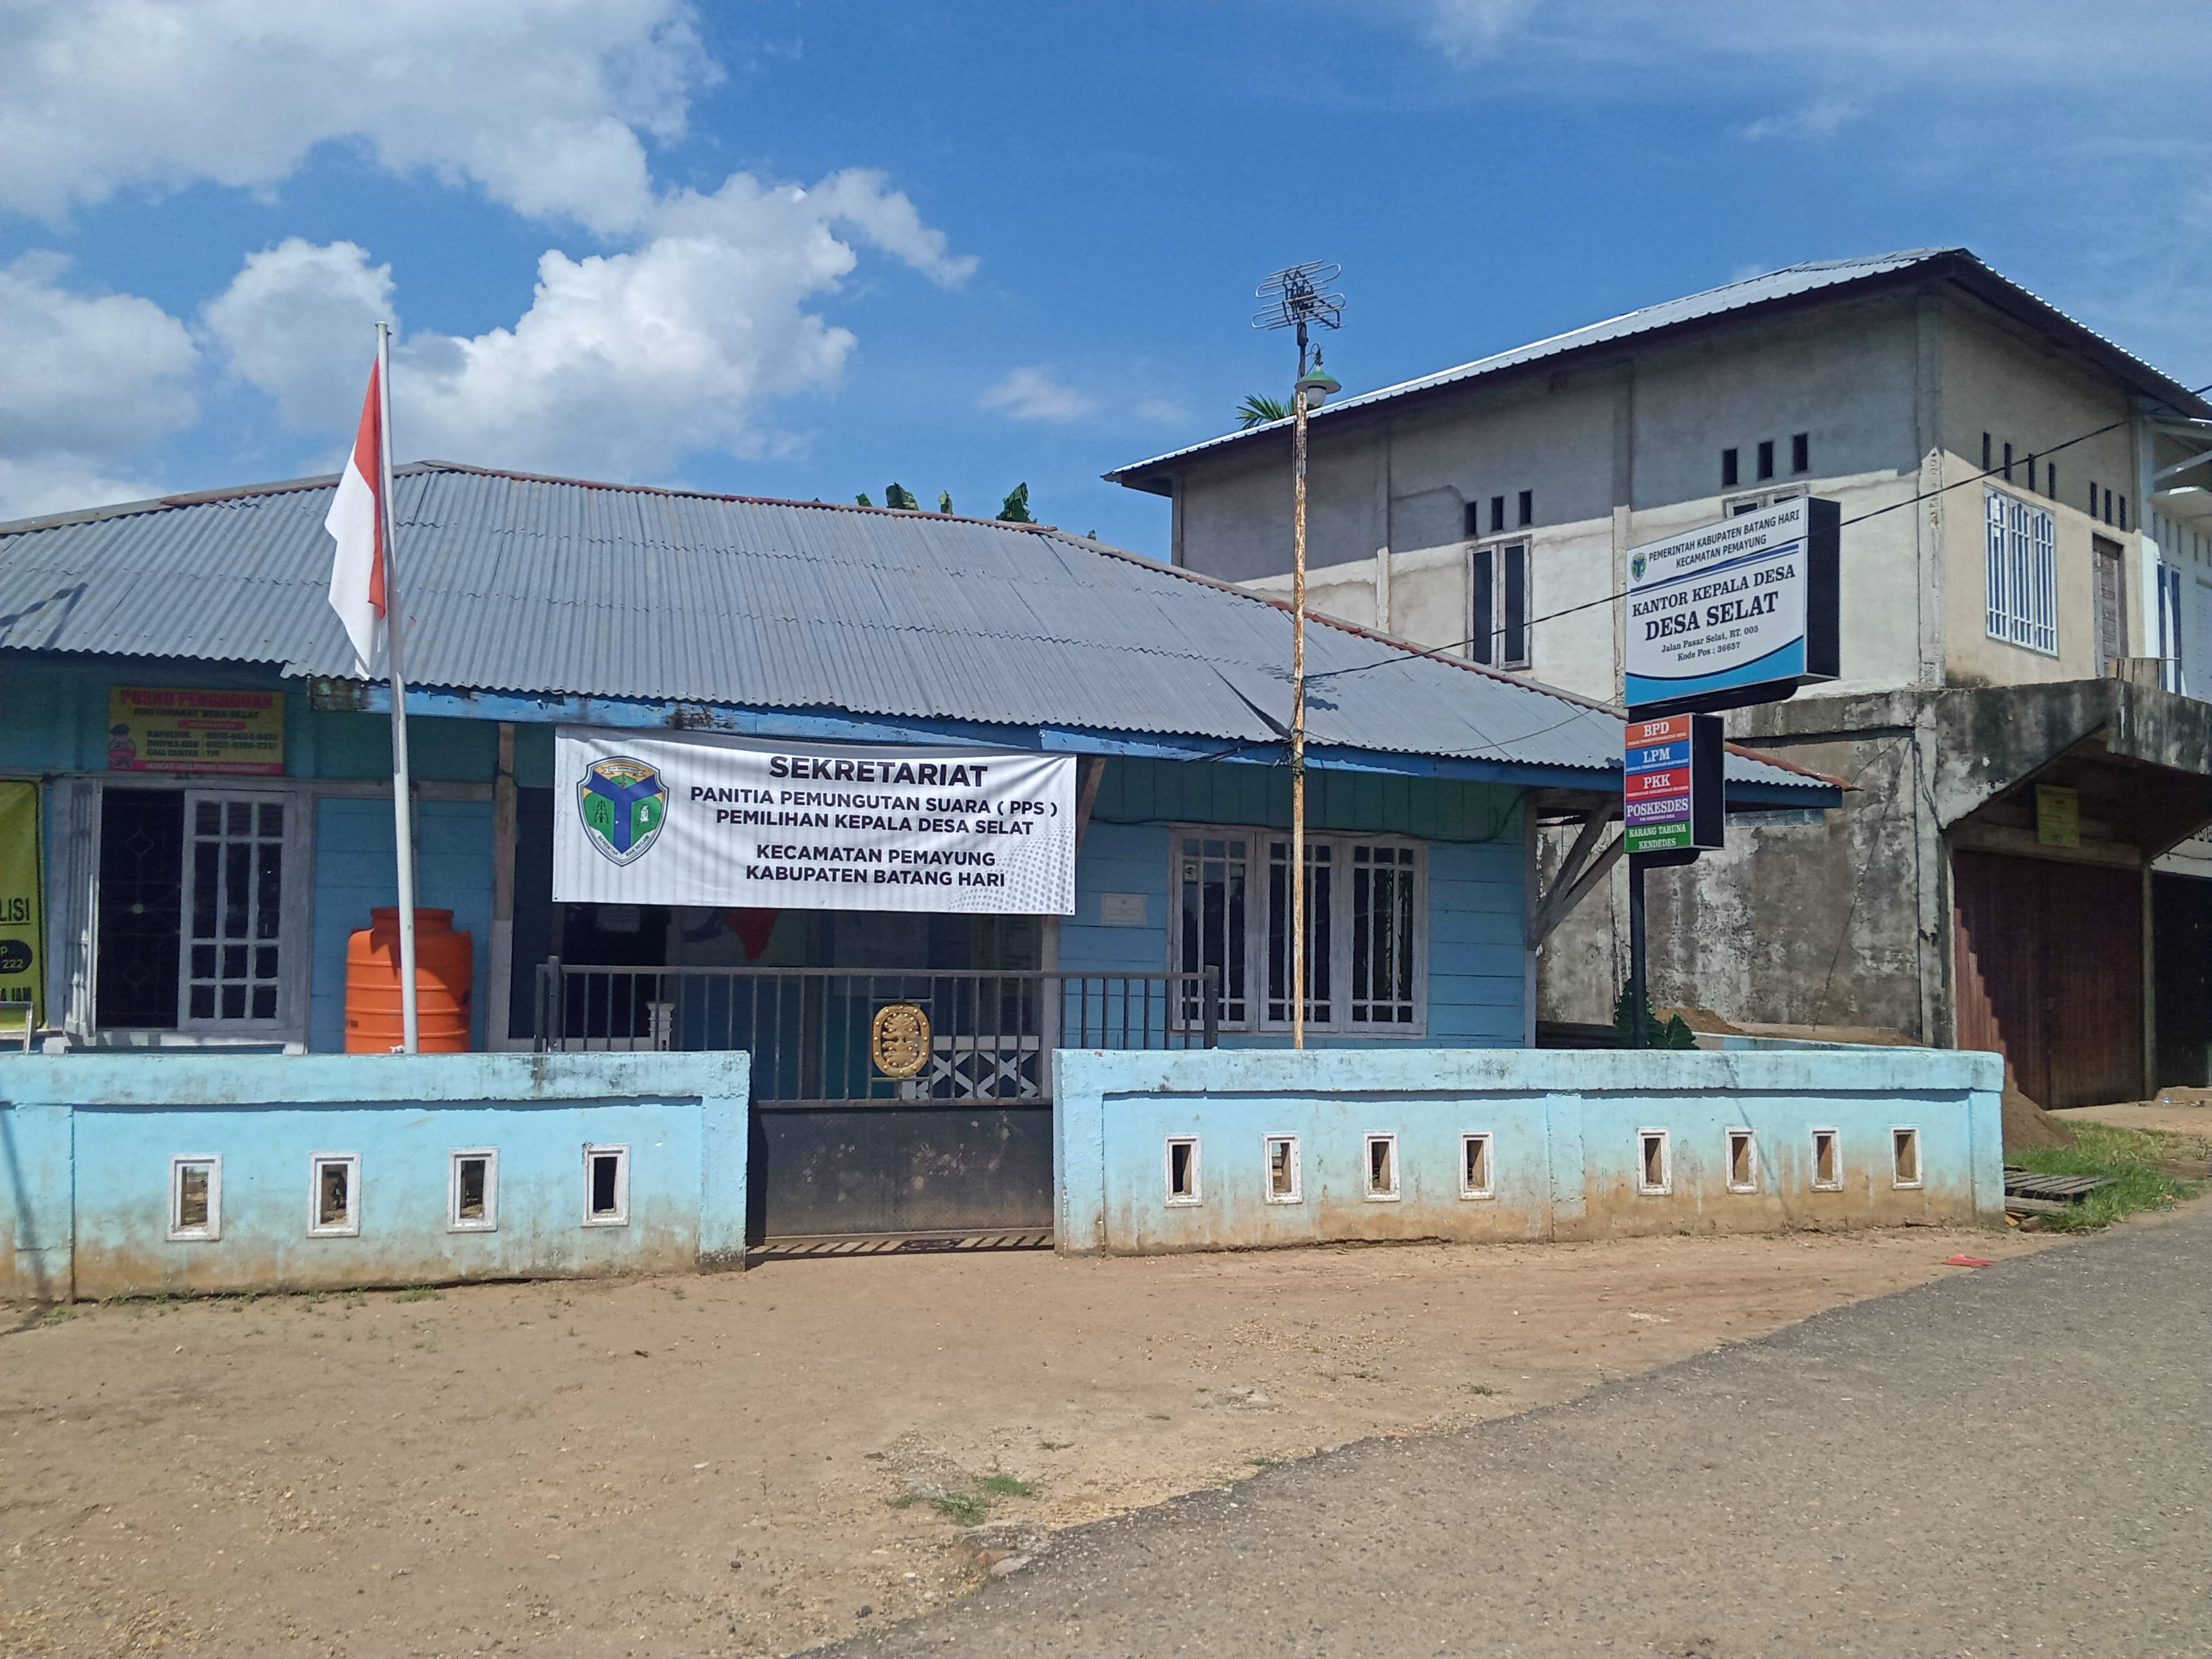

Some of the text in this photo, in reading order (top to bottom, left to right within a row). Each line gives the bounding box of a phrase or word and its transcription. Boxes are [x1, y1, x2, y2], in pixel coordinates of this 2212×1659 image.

[1649, 510, 1800, 562] PEMERINTAH KABUPATEN BATANG HARI
[1676, 535, 1766, 569] KECAMATAN PEMAYUNG
[1632, 564, 1795, 617] KANTOR KEPALA DESA
[1645, 591, 1778, 640] DESA SELAT
[1662, 644, 1681, 653] Jalan
[1683, 638, 1704, 649] Pasar
[1744, 625, 1759, 635] 005
[1677, 652, 1696, 661] Kode
[1698, 648, 1711, 657] Pos
[1717, 641, 1741, 653] 36657
[1643, 720, 1670, 738] BPD
[1643, 747, 1671, 764] LPM
[769, 756, 988, 787] SEKRETARIAT
[1643, 773, 1671, 790] PKK
[691, 786, 774, 804] PANITIA
[781, 791, 920, 811] PEMUNGUTAN
[926, 797, 991, 814] SUARA
[1626, 798, 1689, 817] POSKESDES
[716, 808, 1034, 836] PEMILIHAN KEPALA DESA SELAT
[1629, 823, 1687, 838] KARANG TARUNA
[757, 844, 996, 866] KECAMATAN PEMAYUNG
[1639, 838, 1677, 850] KENDEDES
[746, 865, 1005, 886] KABUPATEN BATANG HARI
